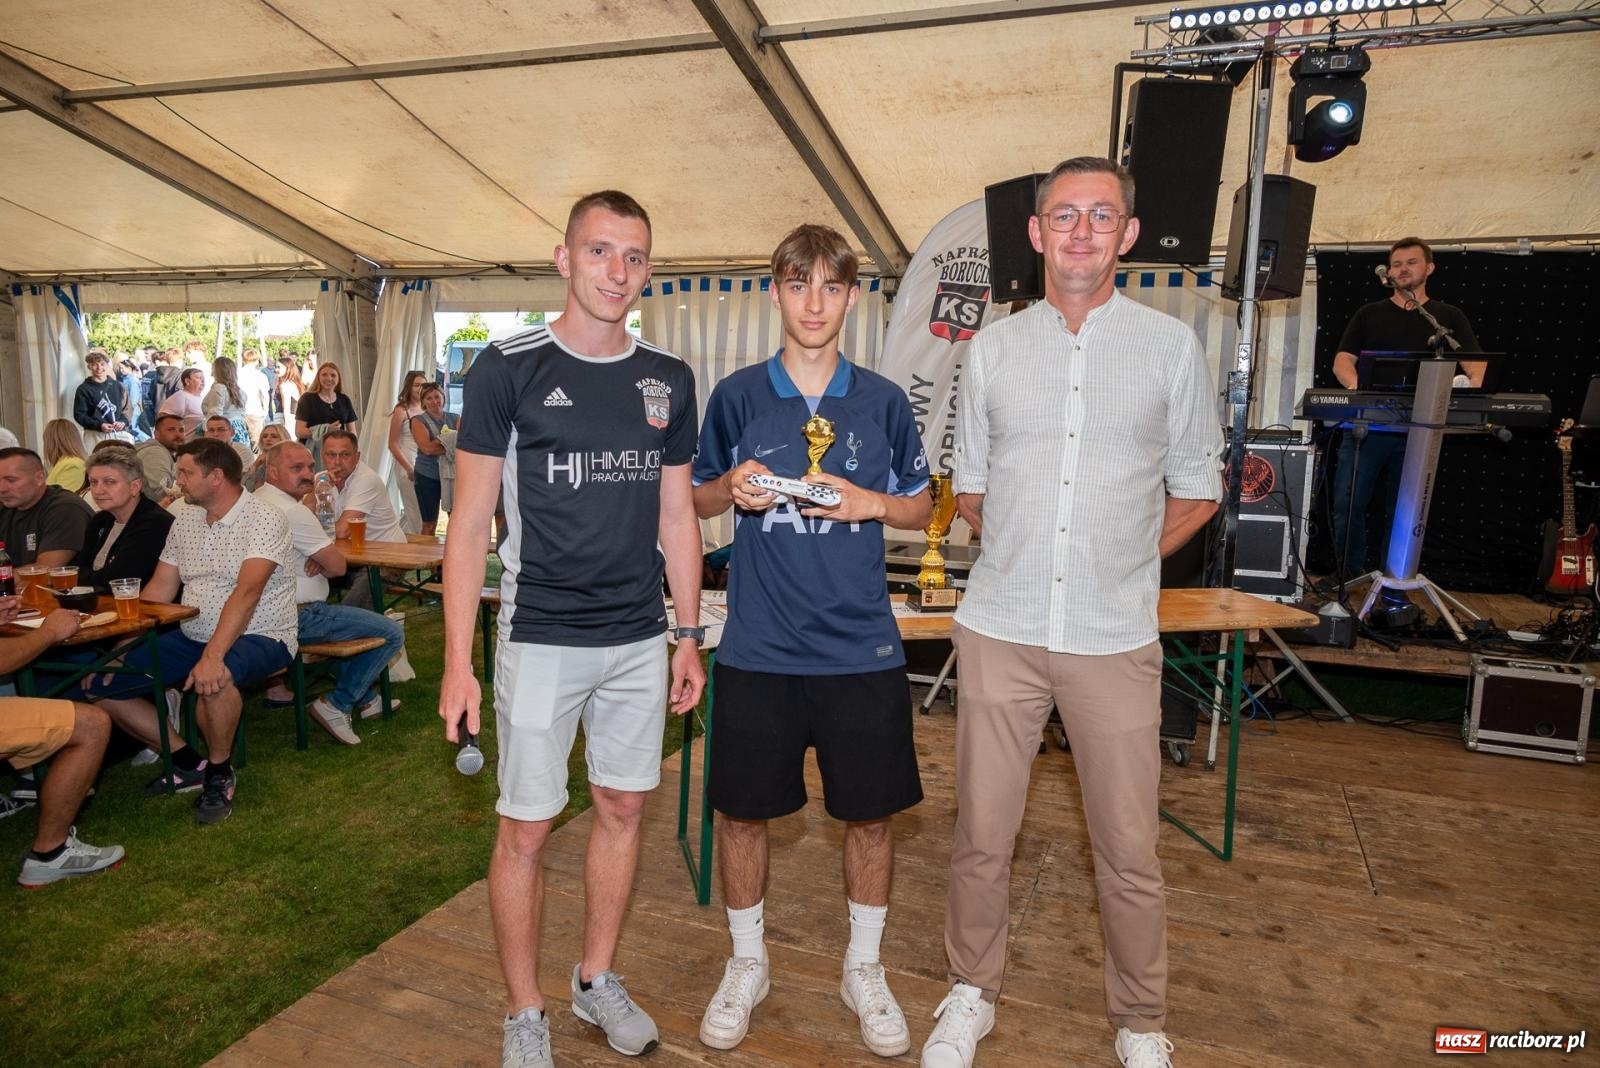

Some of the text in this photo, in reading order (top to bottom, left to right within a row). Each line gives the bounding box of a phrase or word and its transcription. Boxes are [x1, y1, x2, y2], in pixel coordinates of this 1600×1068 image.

[932, 247, 990, 268] NAPRZ
[938, 297, 980, 326] KS
[544, 398, 573, 406] adidas
[1320, 396, 1349, 405] YAMAHA
[648, 404, 668, 420] KS
[548, 452, 582, 490] HJ
[591, 472, 626, 482] PRACA
[627, 471, 637, 481] W
